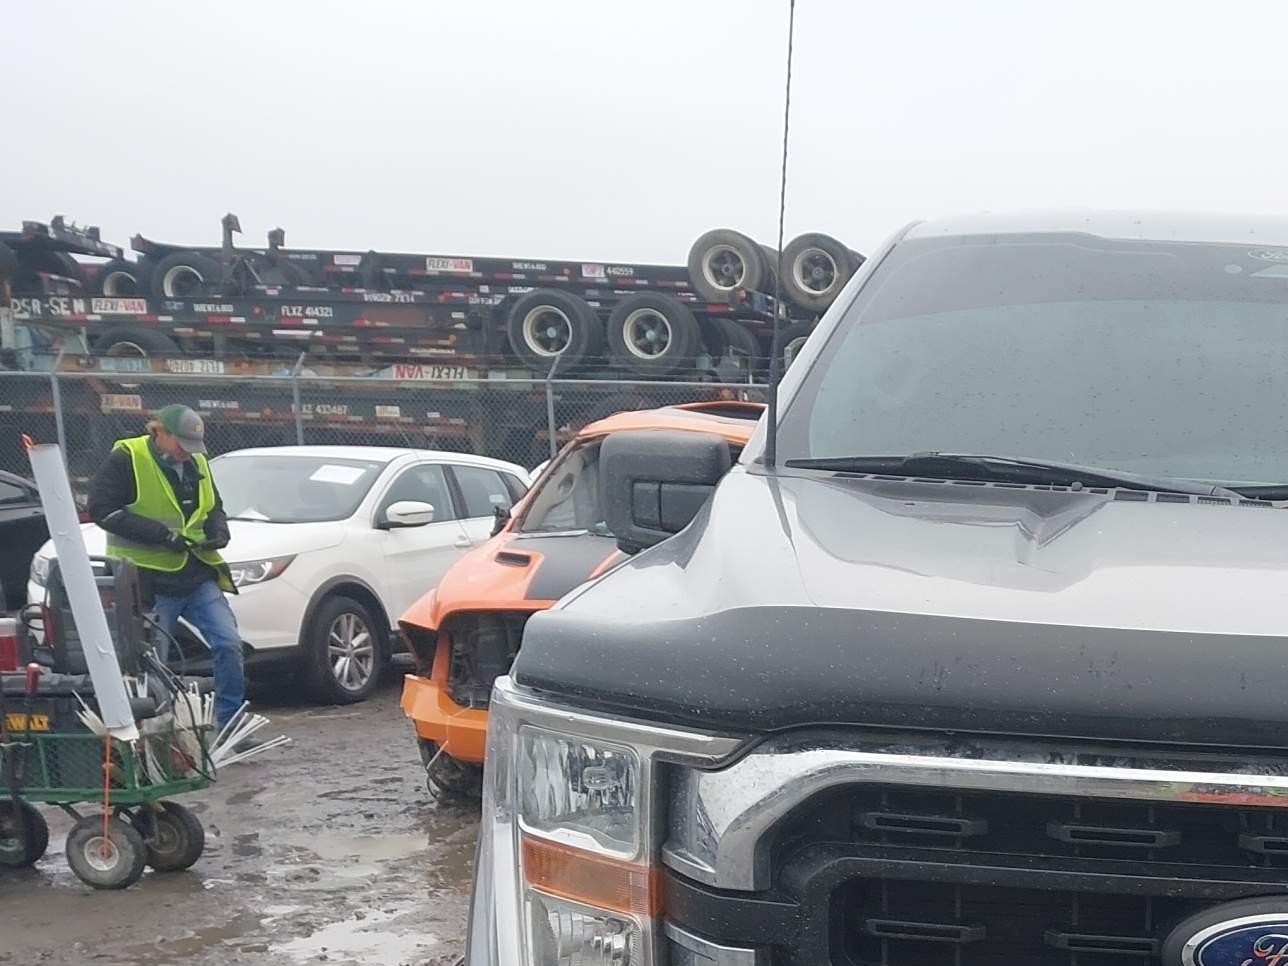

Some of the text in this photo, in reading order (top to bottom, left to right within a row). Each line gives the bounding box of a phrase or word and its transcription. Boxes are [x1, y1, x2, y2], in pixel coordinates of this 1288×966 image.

[94, 299, 146, 312] FLEXI-VAN
[281, 305, 303, 316] FLXZ
[394, 365, 465, 380] FLEXI-VAN
